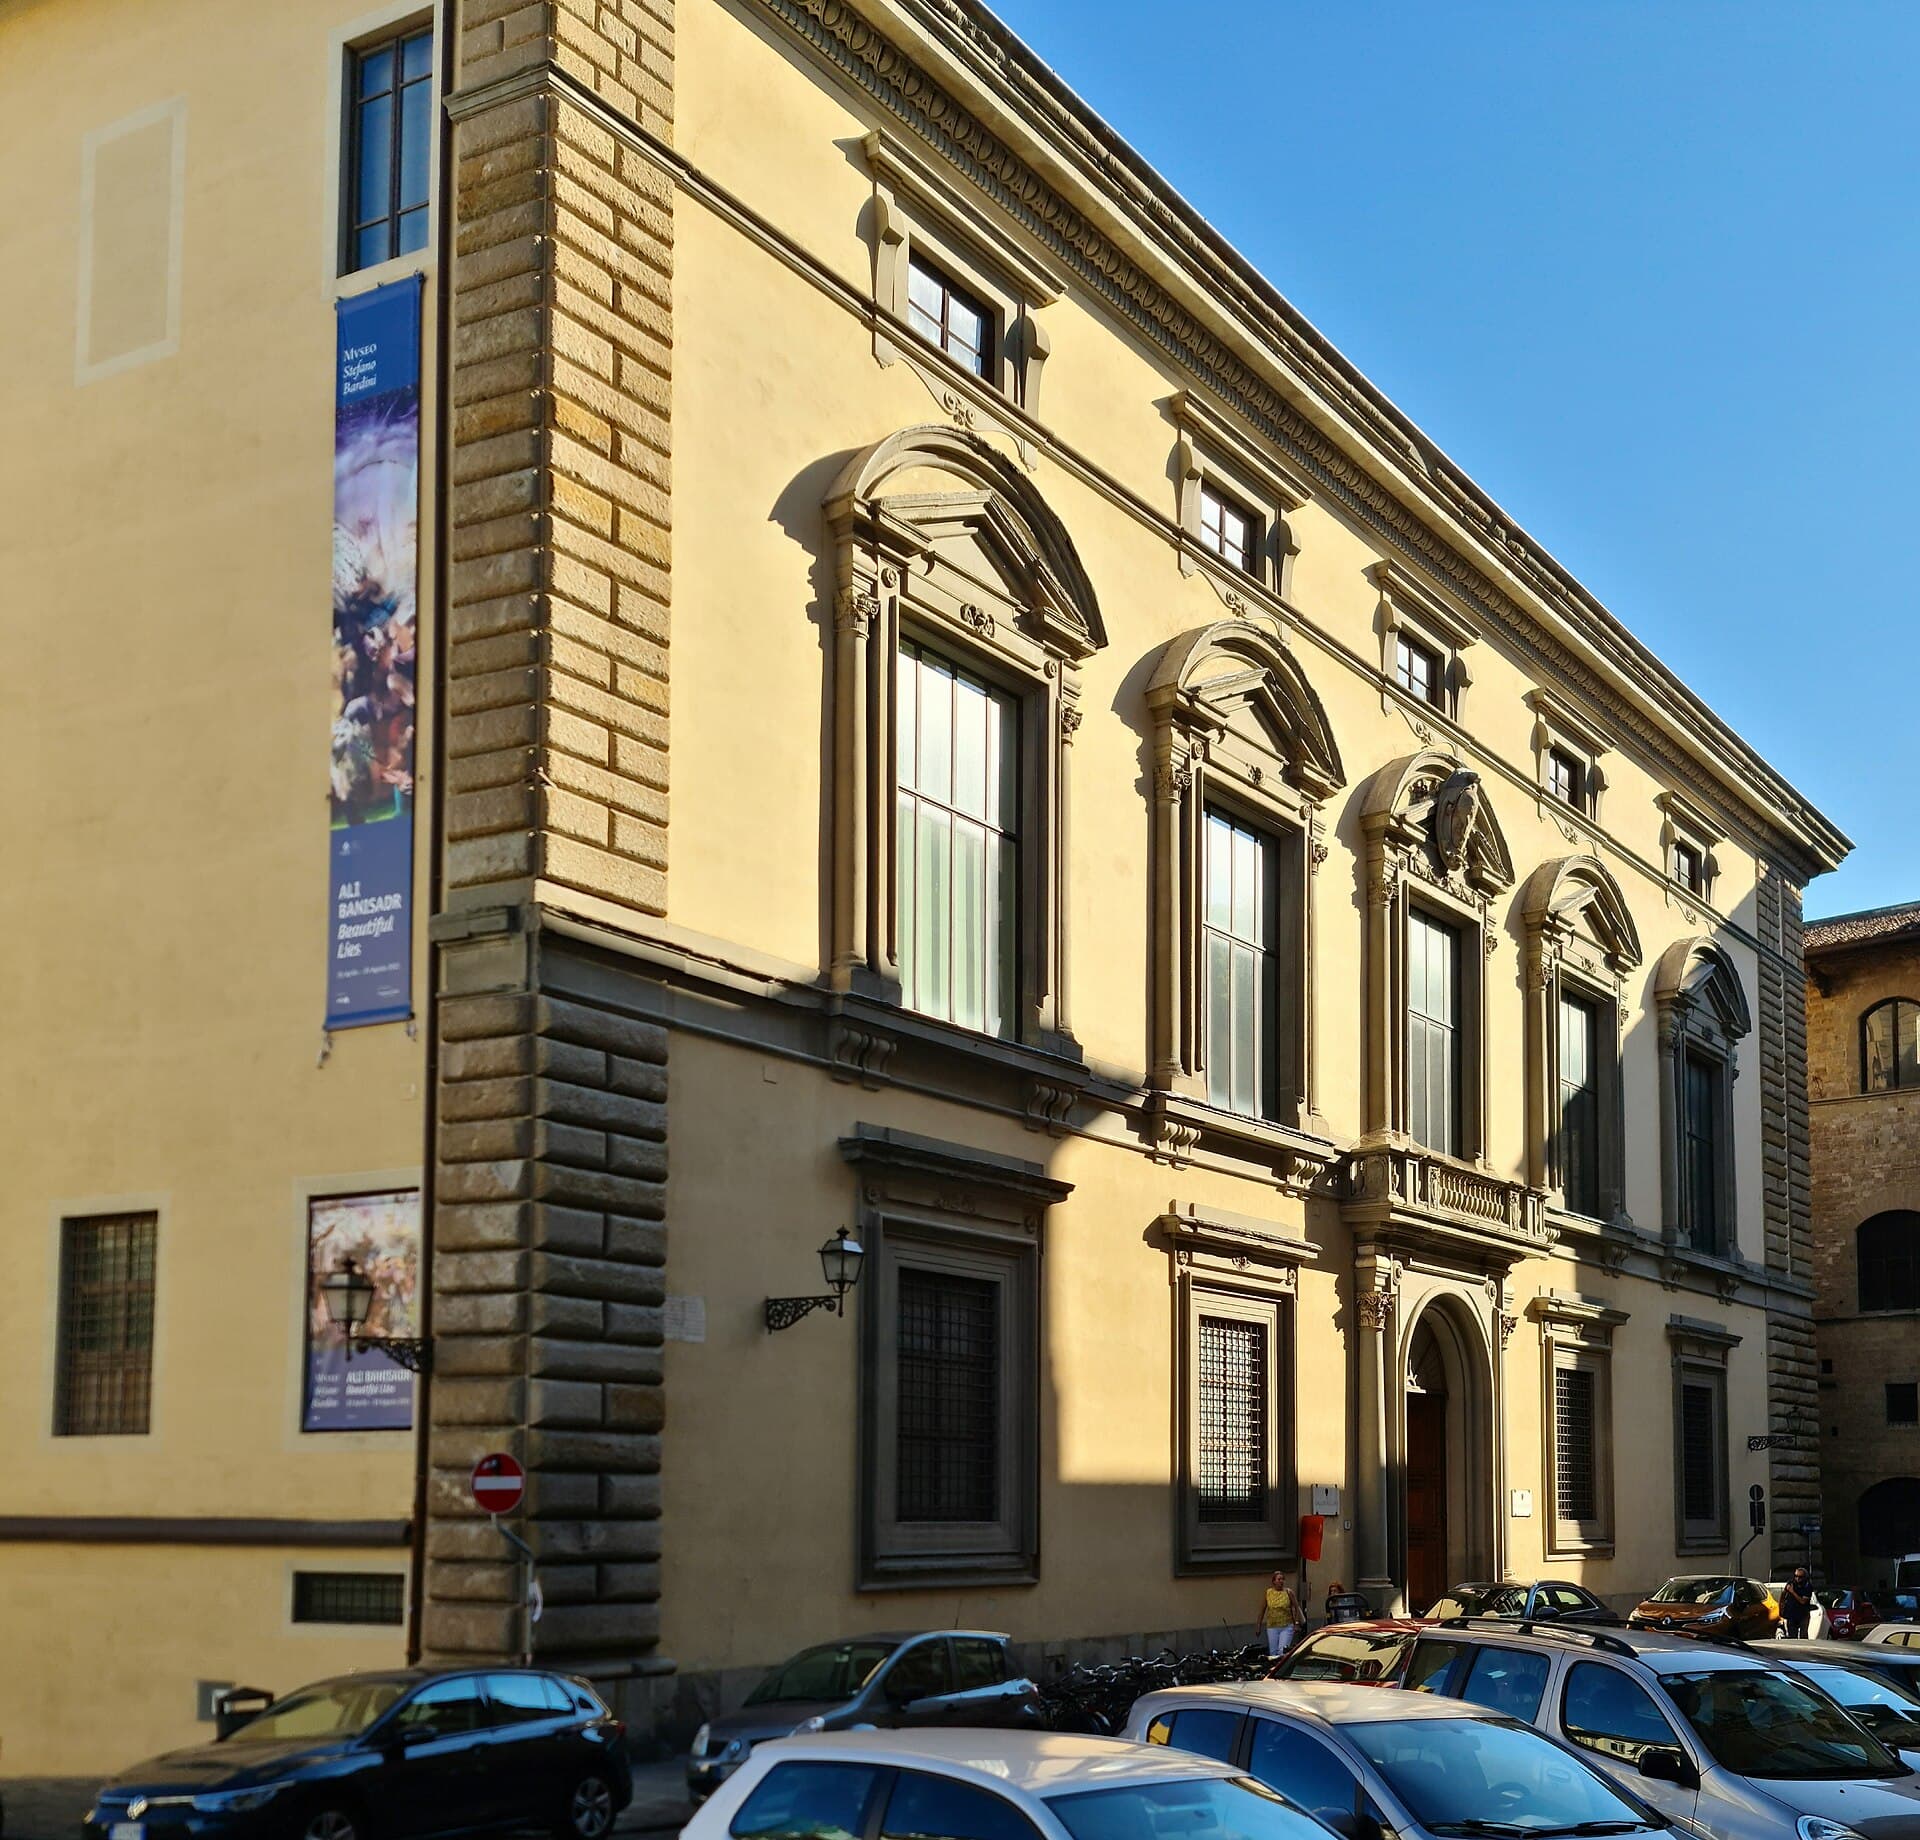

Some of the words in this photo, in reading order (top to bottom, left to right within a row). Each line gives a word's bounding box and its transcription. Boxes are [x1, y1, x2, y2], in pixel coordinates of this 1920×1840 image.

[343, 359, 377, 380] Stefano
[343, 374, 377, 395] Bardini
[338, 880, 361, 900] ALI
[338, 892, 402, 919] BANISADR
[337, 914, 395, 939] Beautiful
[336, 941, 362, 959] Lies
